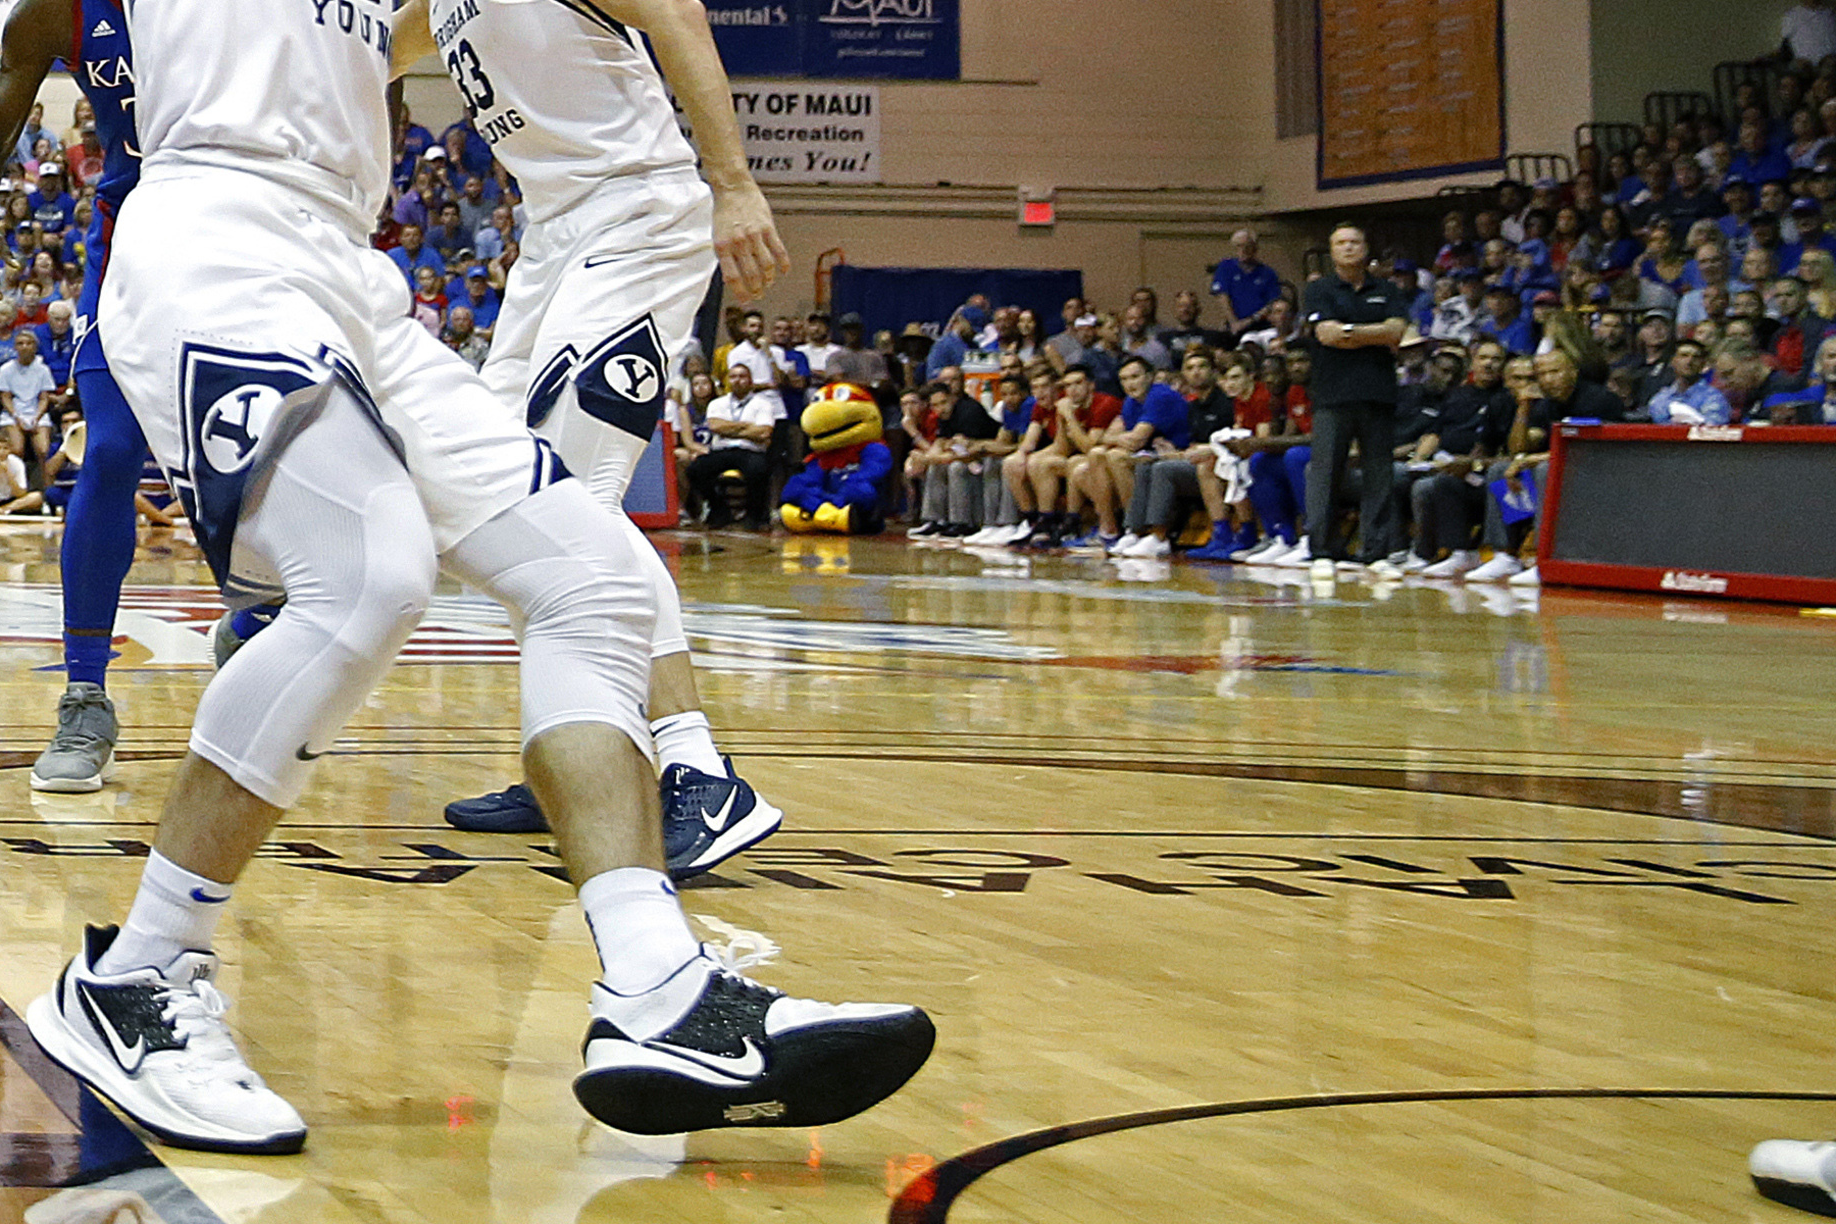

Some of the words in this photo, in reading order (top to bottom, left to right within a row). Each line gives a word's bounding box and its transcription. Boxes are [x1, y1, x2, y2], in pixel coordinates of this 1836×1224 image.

[766, 93, 798, 115] OF
[806, 94, 872, 116] MAUI
[746, 125, 864, 142] Recreation
[805, 151, 872, 173] You!
